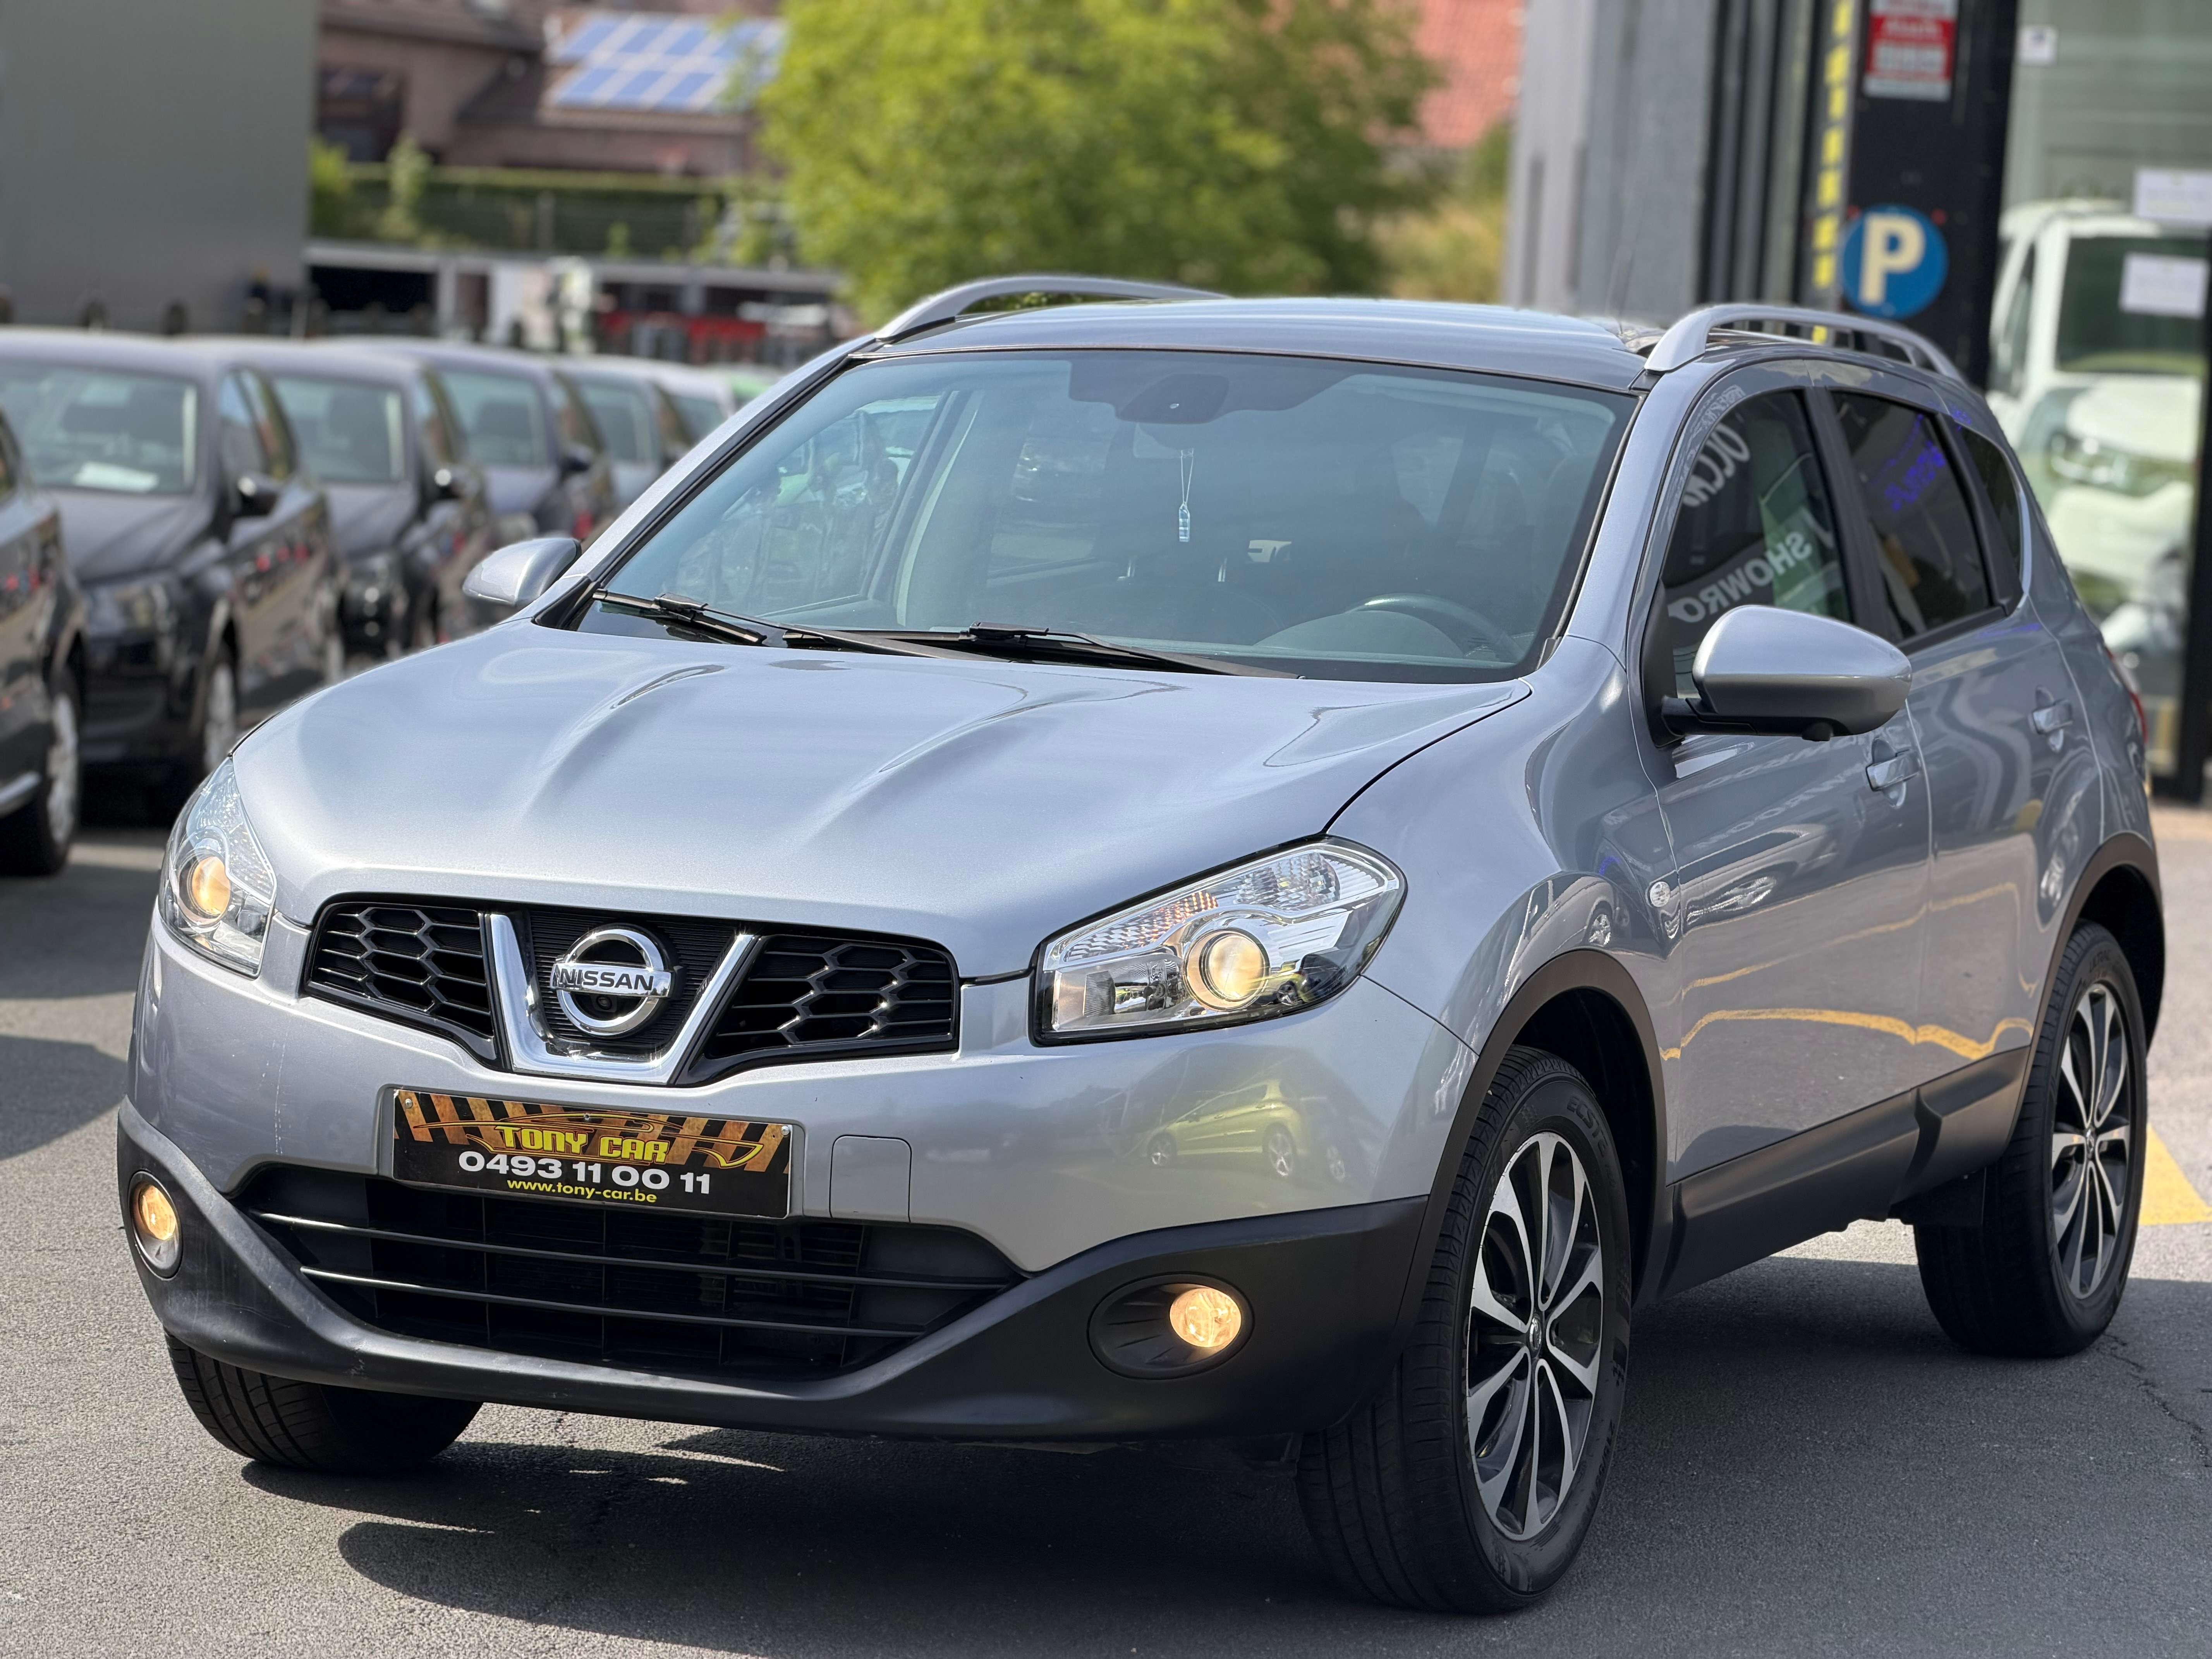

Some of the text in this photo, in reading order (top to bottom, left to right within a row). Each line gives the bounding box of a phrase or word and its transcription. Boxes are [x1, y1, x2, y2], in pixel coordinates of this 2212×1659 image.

[1858, 213, 1925, 305] P
[560, 968, 654, 991] NISSAN
[495, 1125, 670, 1163] TONY CAR
[459, 1151, 710, 1194] 0493 11 00 11
[507, 1179, 657, 1203] www.tony-car.be
